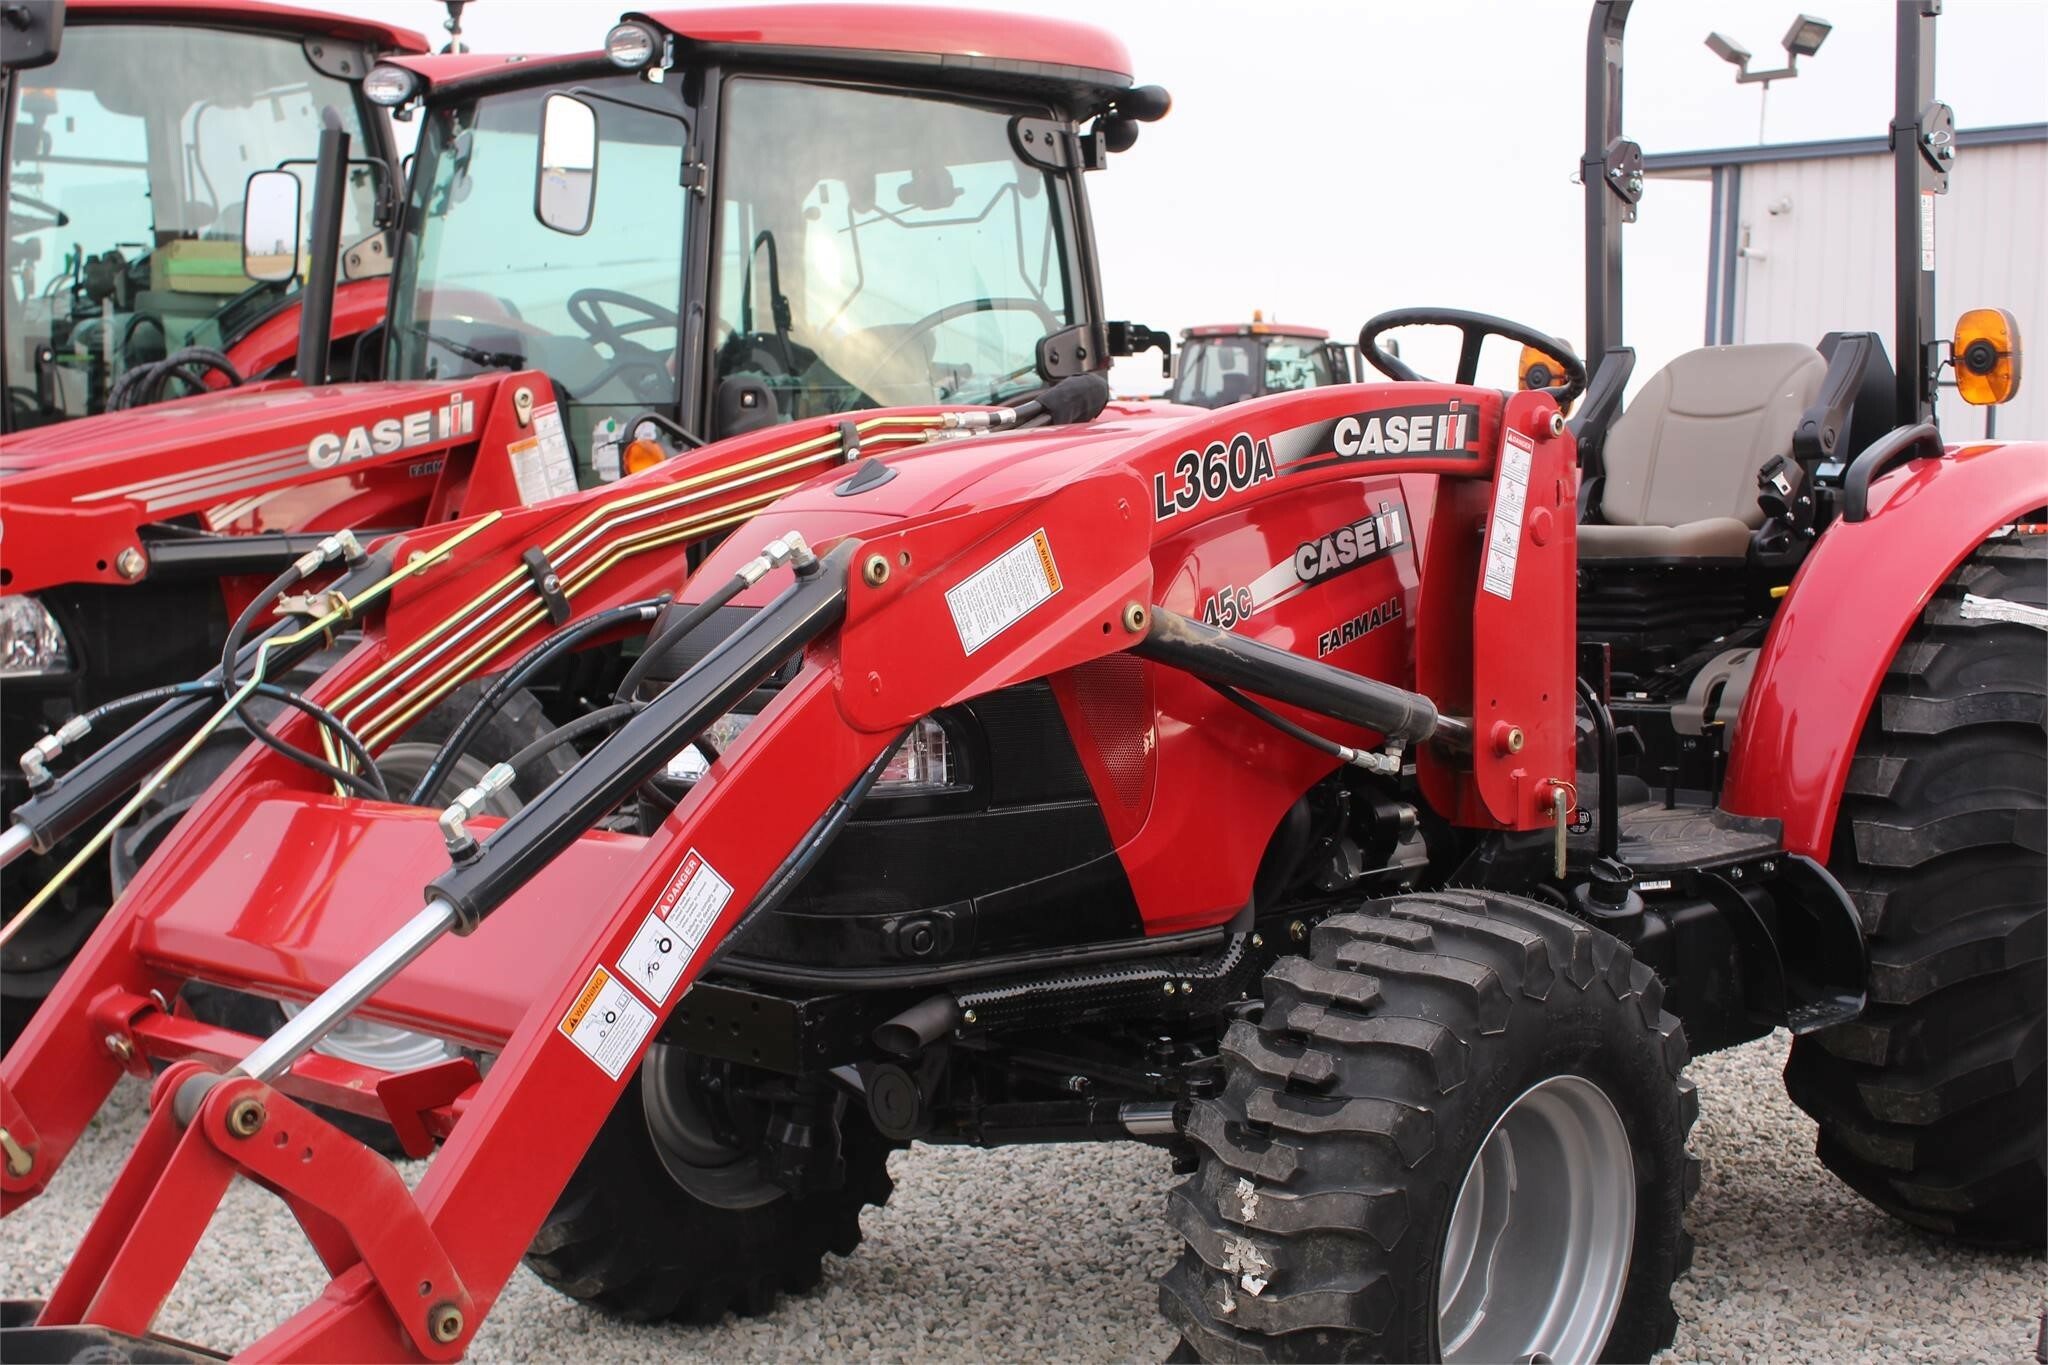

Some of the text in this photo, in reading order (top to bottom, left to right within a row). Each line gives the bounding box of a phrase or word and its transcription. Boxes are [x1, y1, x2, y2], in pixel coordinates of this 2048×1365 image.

[307, 410, 432, 470] CASE
[1332, 414, 1433, 457] CASE
[1154, 431, 1275, 522] L360A
[1040, 547, 1056, 587] WARNING
[1294, 518, 1377, 583] CASE
[1202, 584, 1254, 631] 45C
[1317, 597, 1402, 659] FARMALL
[666, 858, 697, 904] DANGER
[575, 977, 603, 1017] WARNING
